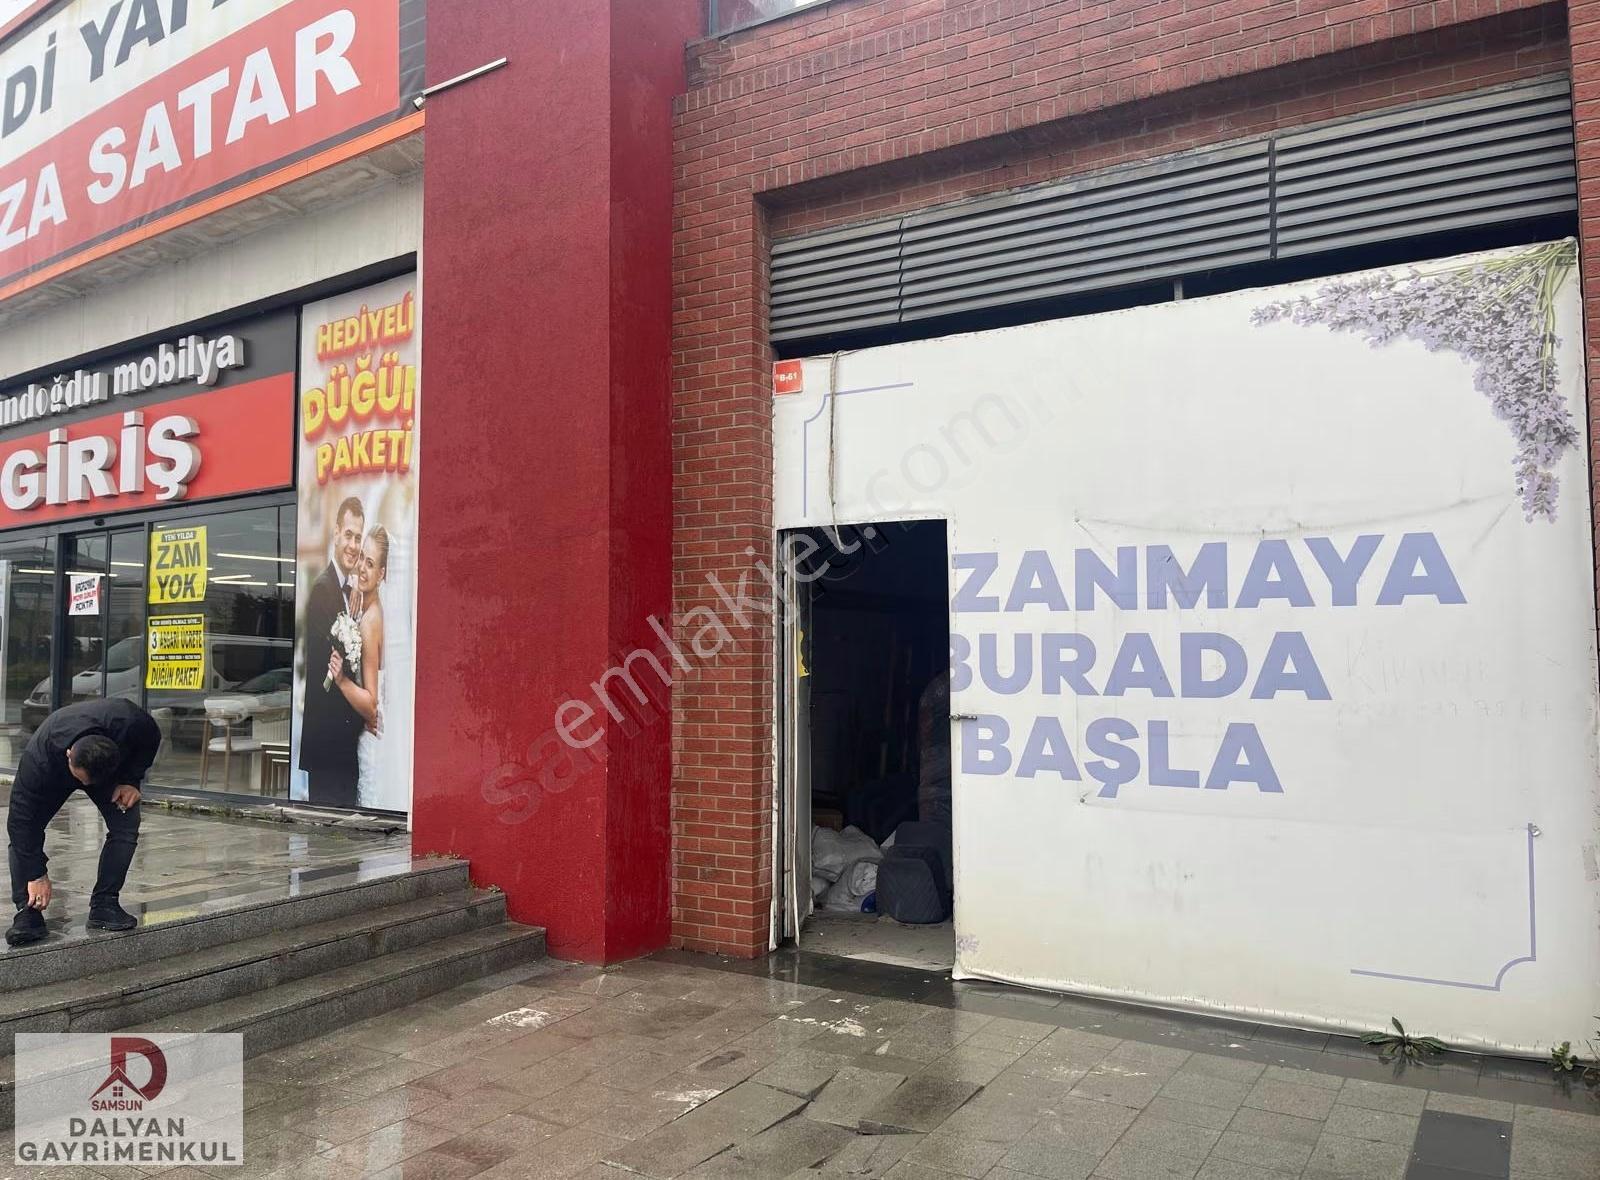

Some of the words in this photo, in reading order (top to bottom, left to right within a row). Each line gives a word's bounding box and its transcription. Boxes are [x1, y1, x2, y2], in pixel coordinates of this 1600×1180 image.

[79, 0, 228, 82] YA
[86, 9, 361, 205] SATAR
[317, 291, 415, 362] HEDİYELİ
[0, 369, 108, 427] ndoğdu
[113, 334, 244, 386] mobilya
[0, 411, 202, 510] GİRİŞ
[316, 419, 414, 485] PAKETİ
[156, 542, 201, 569] ZAM
[951, 531, 1467, 613] ZANMAYA
[151, 631, 158, 650] 3
[175, 662, 200, 686] PAKETİ
[961, 714, 1284, 799] BAŞLA
